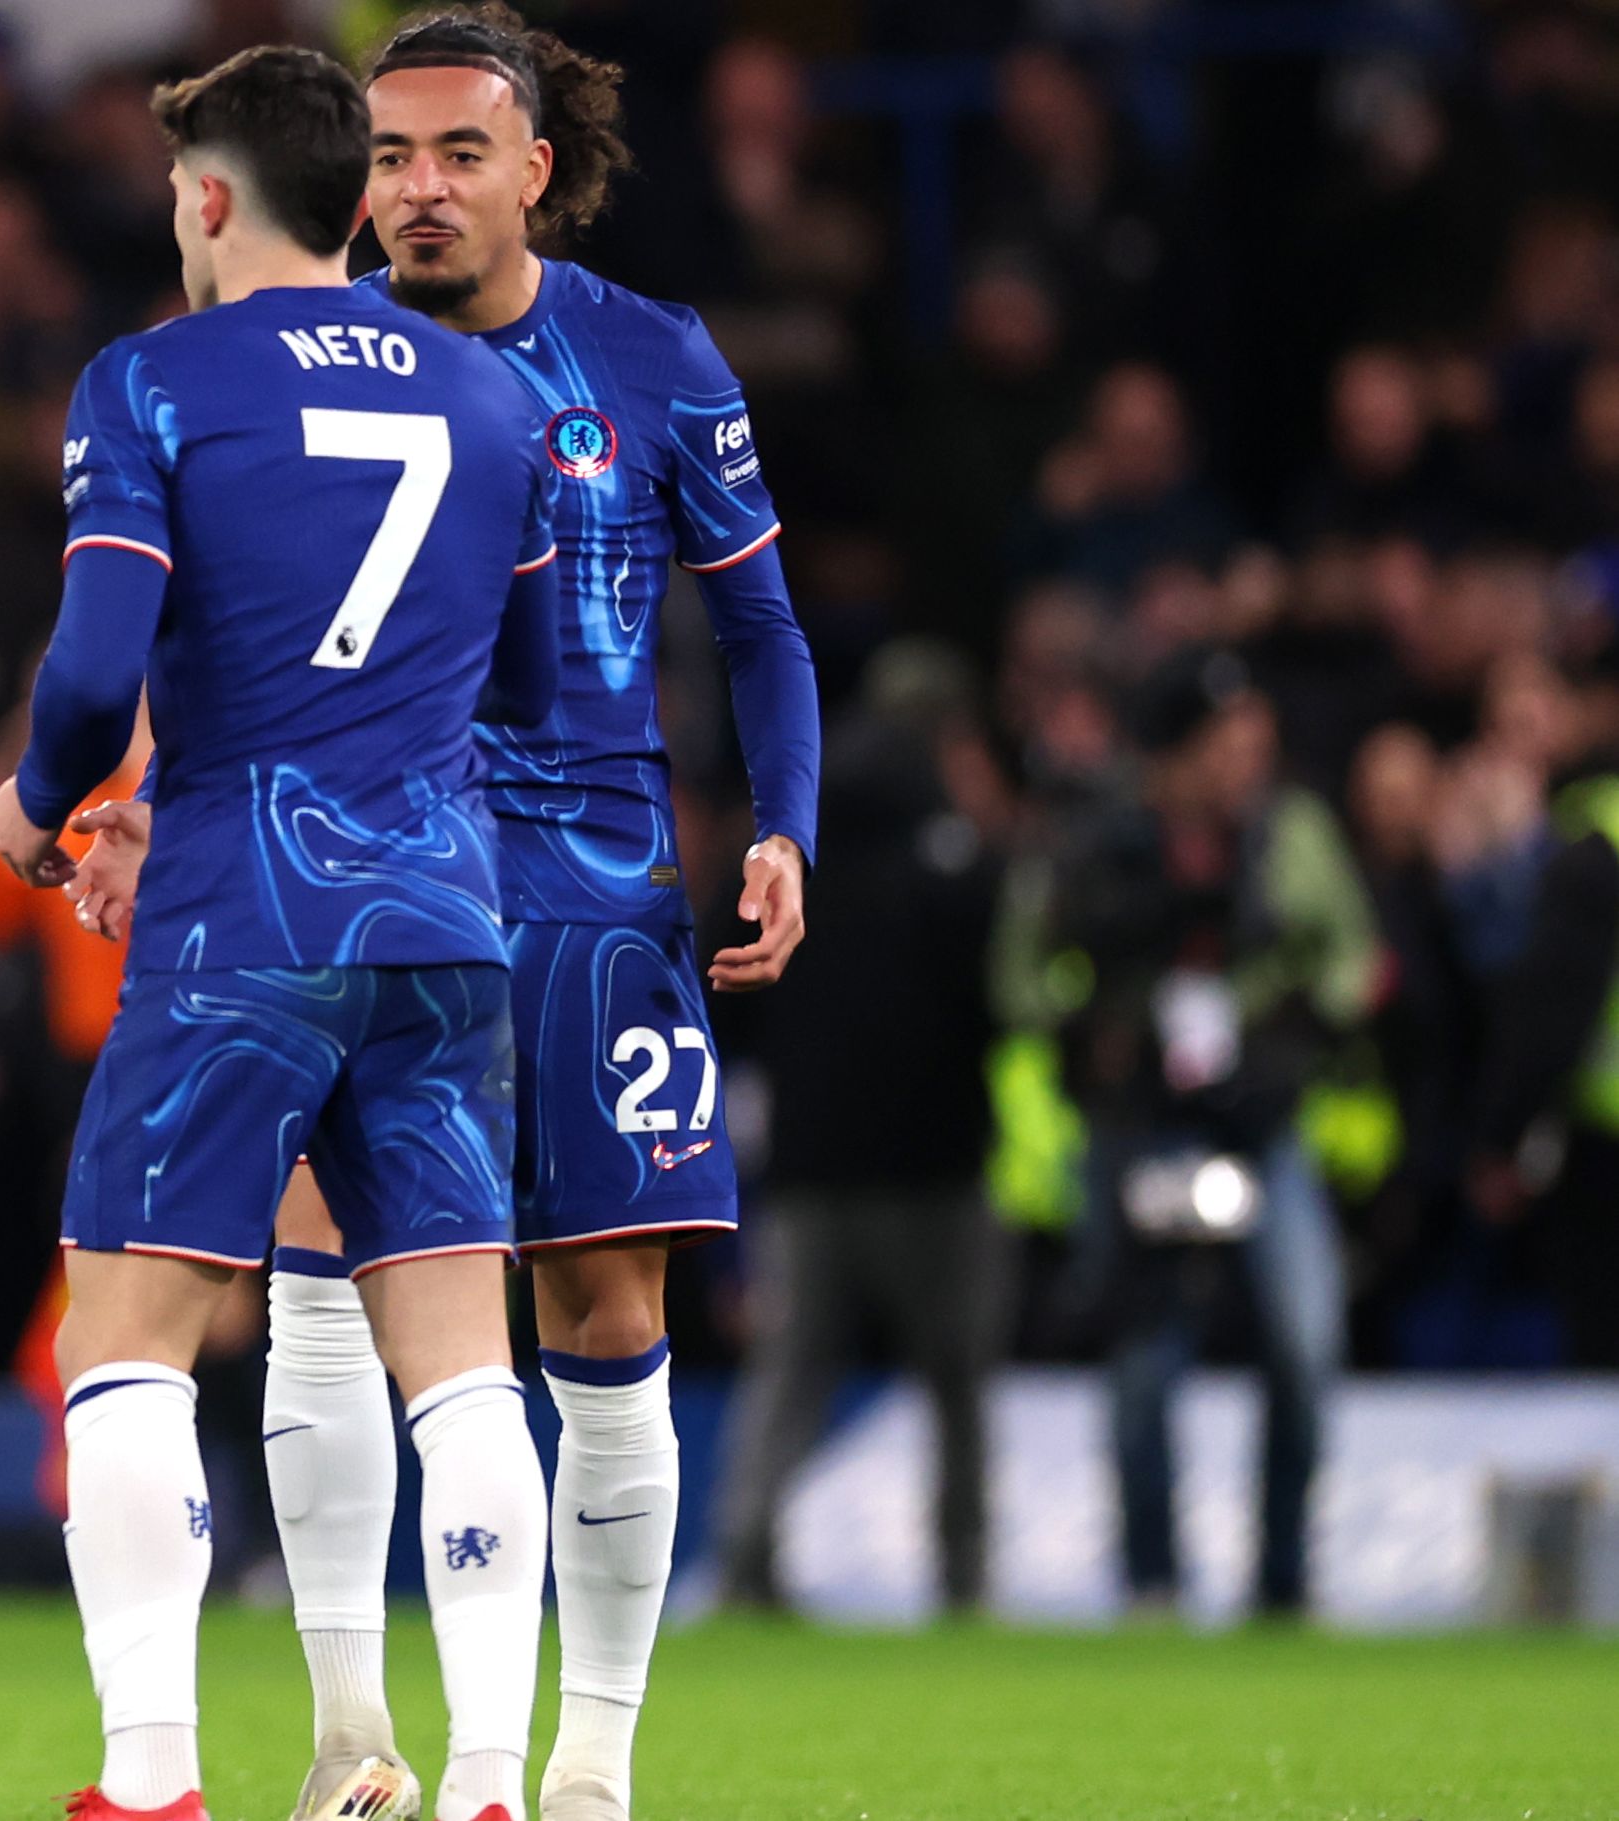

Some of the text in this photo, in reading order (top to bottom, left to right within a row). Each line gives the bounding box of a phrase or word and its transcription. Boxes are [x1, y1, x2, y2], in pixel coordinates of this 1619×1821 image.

[278, 324, 418, 377] NETO
[300, 407, 453, 669] 7
[612, 1026, 717, 1134] 27
